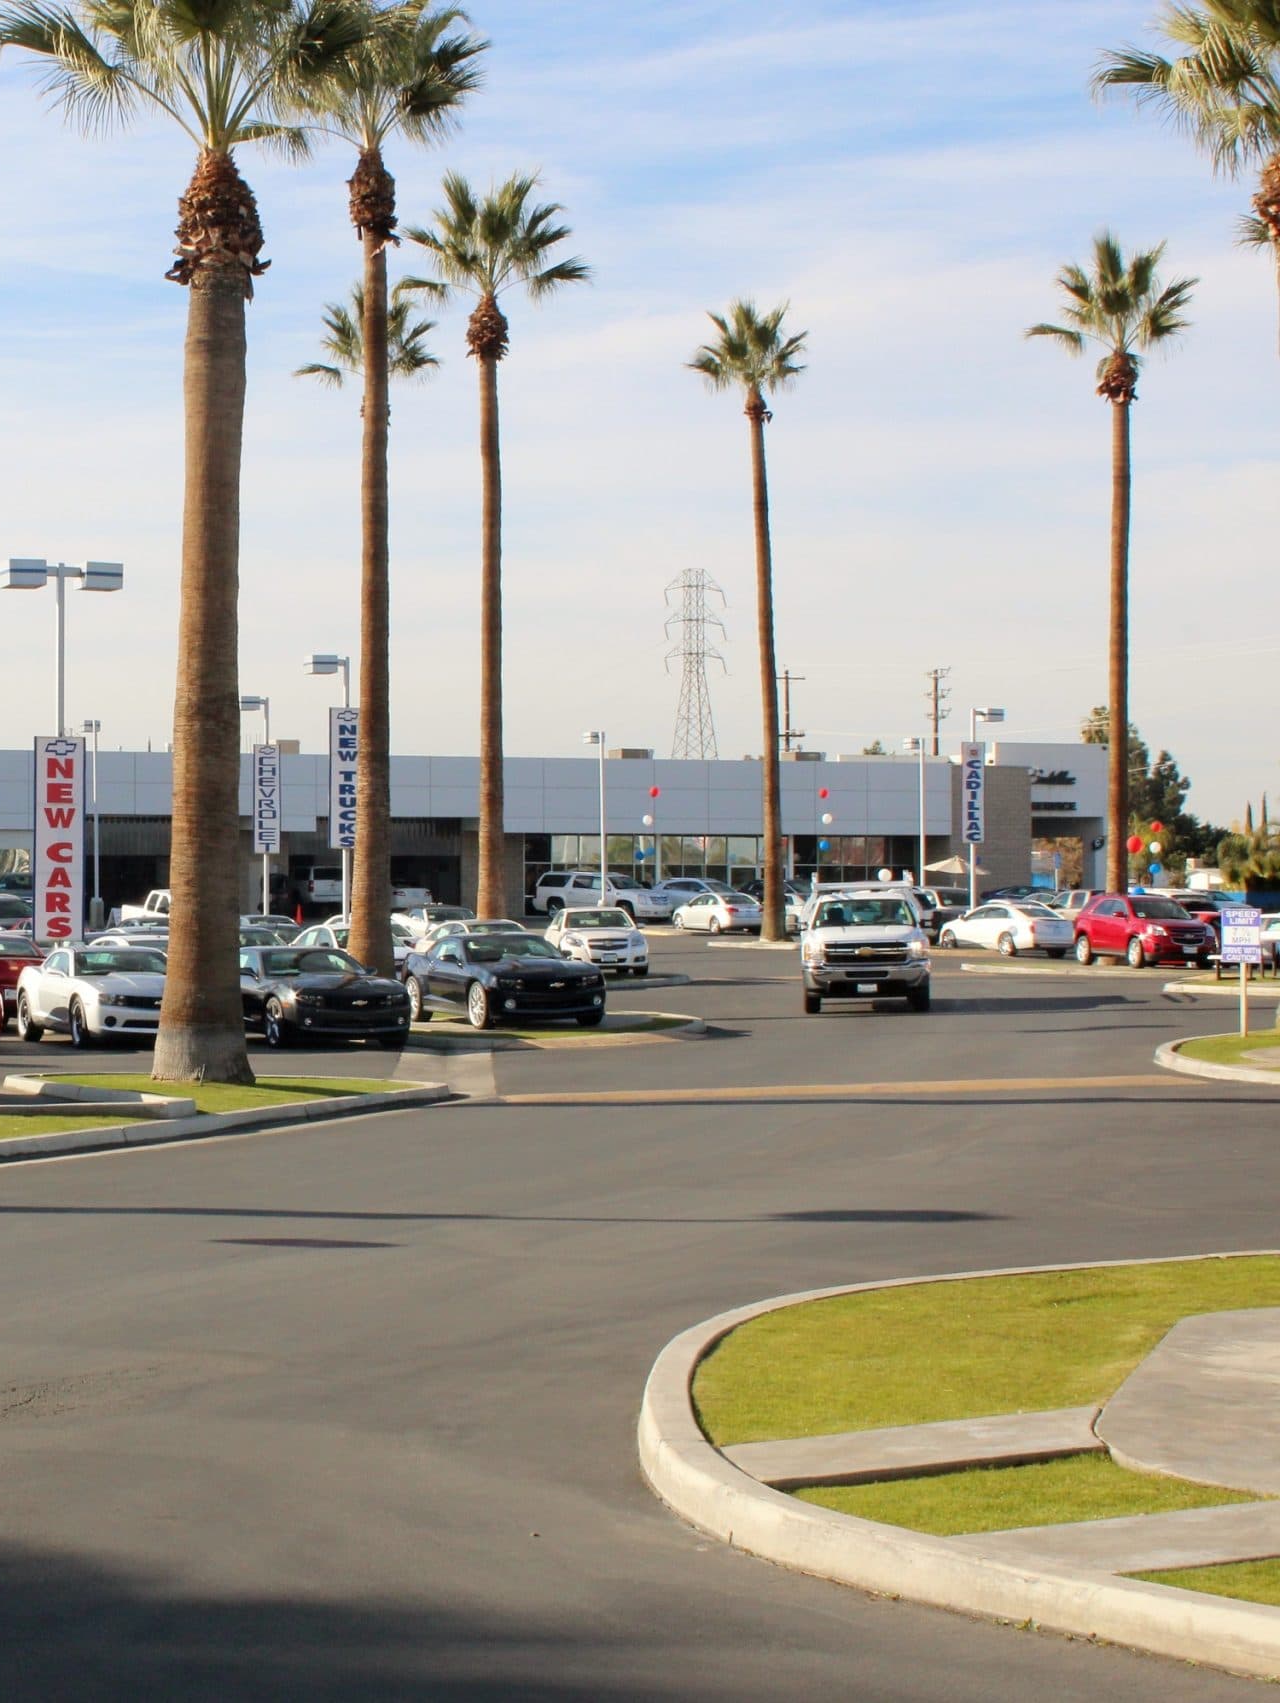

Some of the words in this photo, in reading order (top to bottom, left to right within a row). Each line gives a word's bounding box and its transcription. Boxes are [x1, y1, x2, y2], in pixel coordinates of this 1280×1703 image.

[337, 724, 358, 762] NEW
[44, 757, 76, 829] NEW
[258, 756, 277, 852] CHEVROLET
[339, 770, 357, 848] TRUCKS
[965, 759, 982, 842] CADILLAC
[45, 842, 73, 938] CARS
[1225, 910, 1258, 918] SPEED
[1229, 917, 1255, 925] LIMIT
